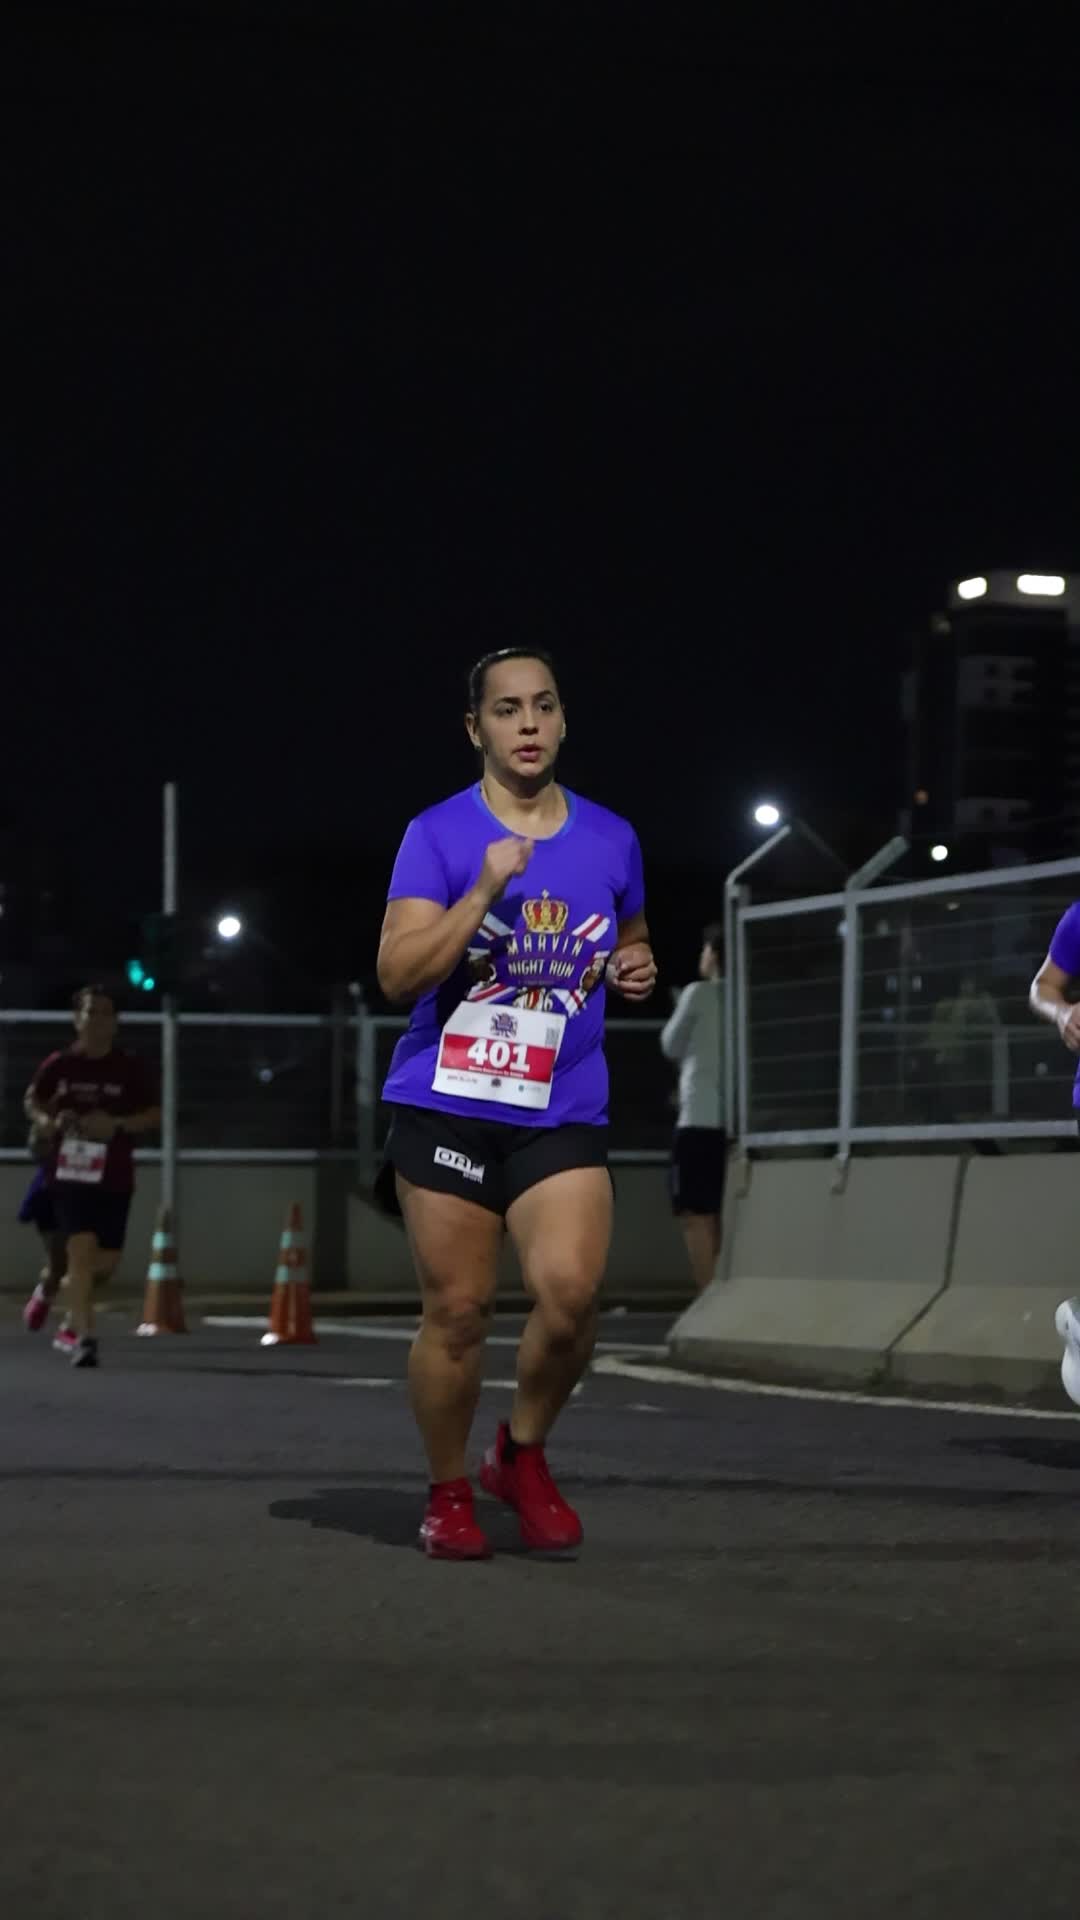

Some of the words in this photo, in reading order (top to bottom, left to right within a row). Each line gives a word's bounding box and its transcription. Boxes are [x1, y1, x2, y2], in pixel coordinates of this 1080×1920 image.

[506, 934, 584, 957] MARVIN
[508, 960, 545, 977] NIGHT
[549, 960, 575, 978] RUN
[467, 1038, 531, 1073] 401
